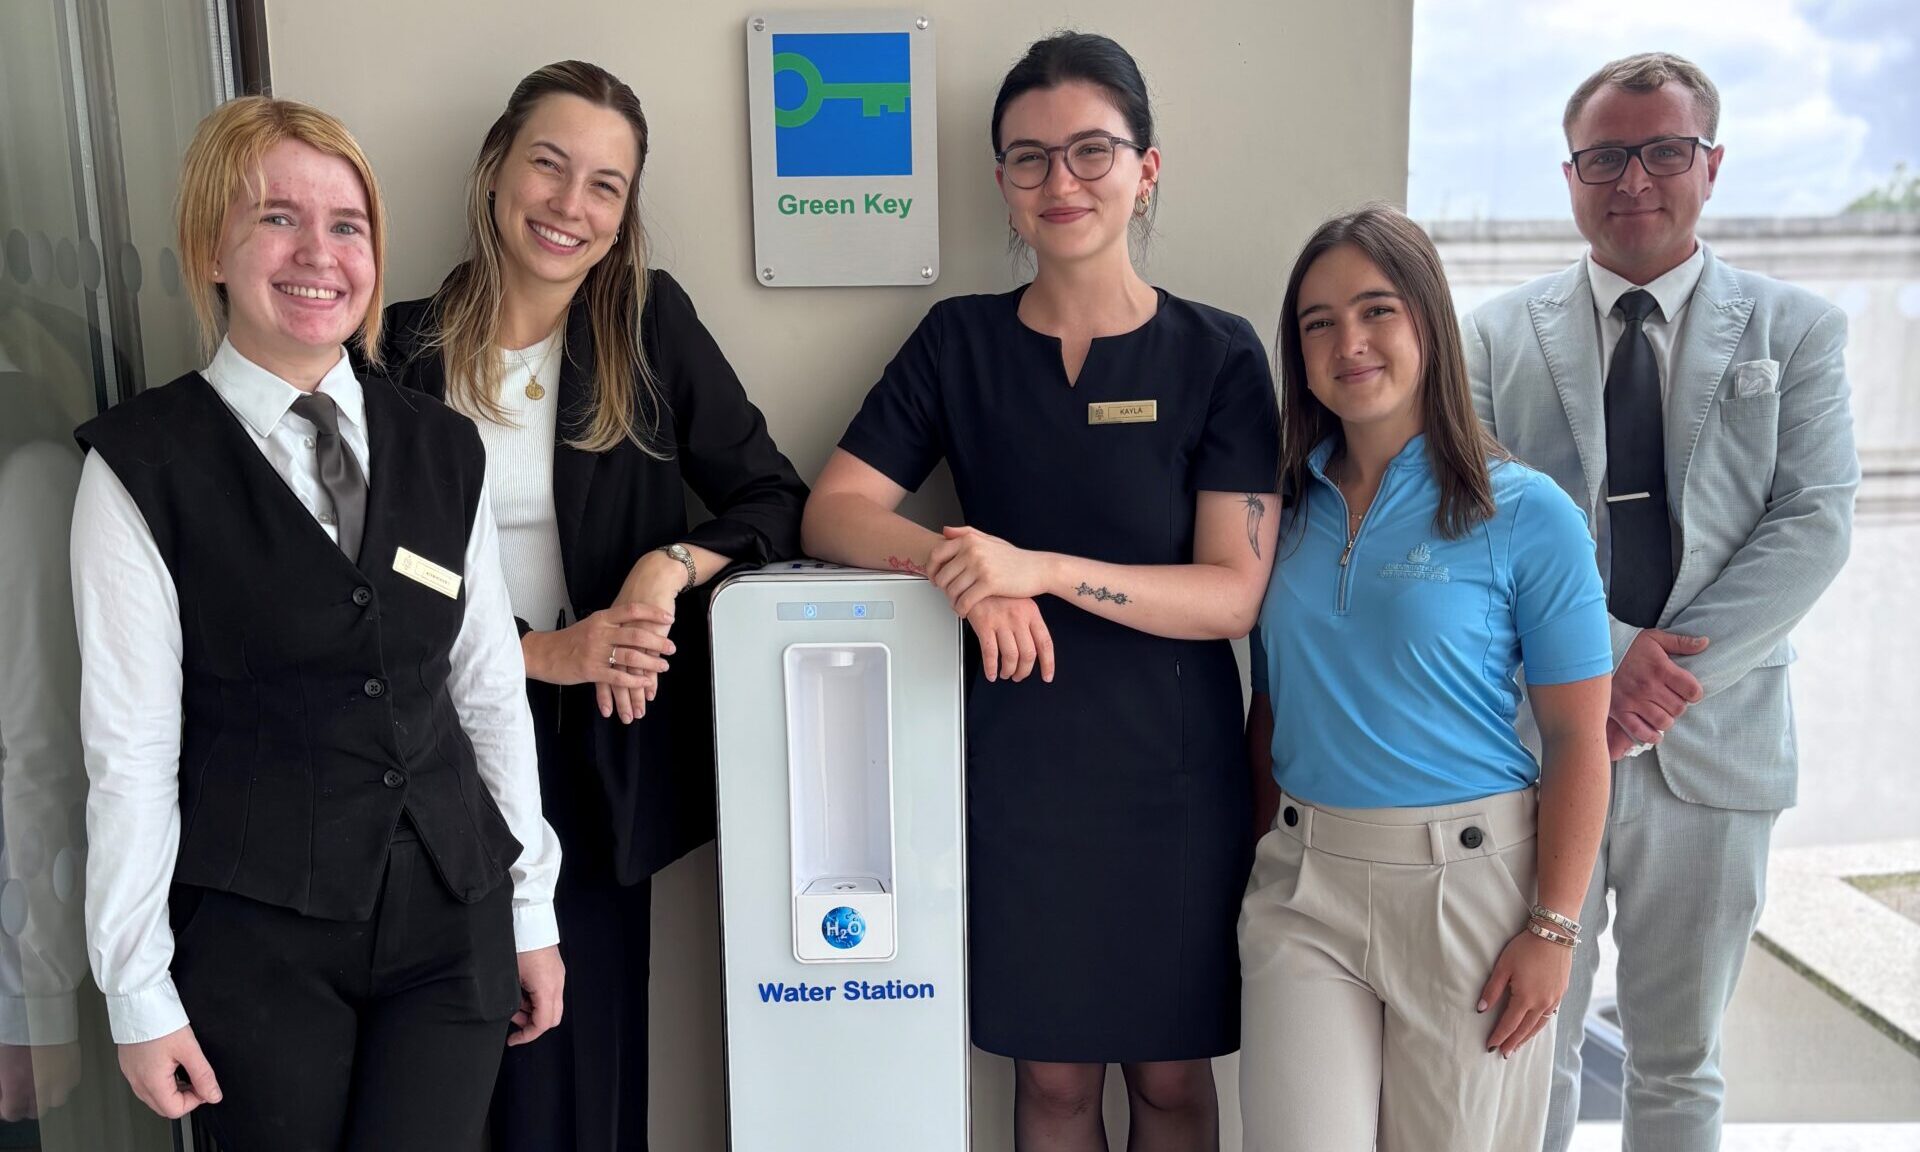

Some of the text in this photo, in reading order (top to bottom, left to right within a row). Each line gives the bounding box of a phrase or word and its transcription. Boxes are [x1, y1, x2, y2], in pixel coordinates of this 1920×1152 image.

[777, 193, 913, 219] Green Key
[1120, 407, 1143, 416] KAYLA
[758, 979, 935, 1003] Water Station
